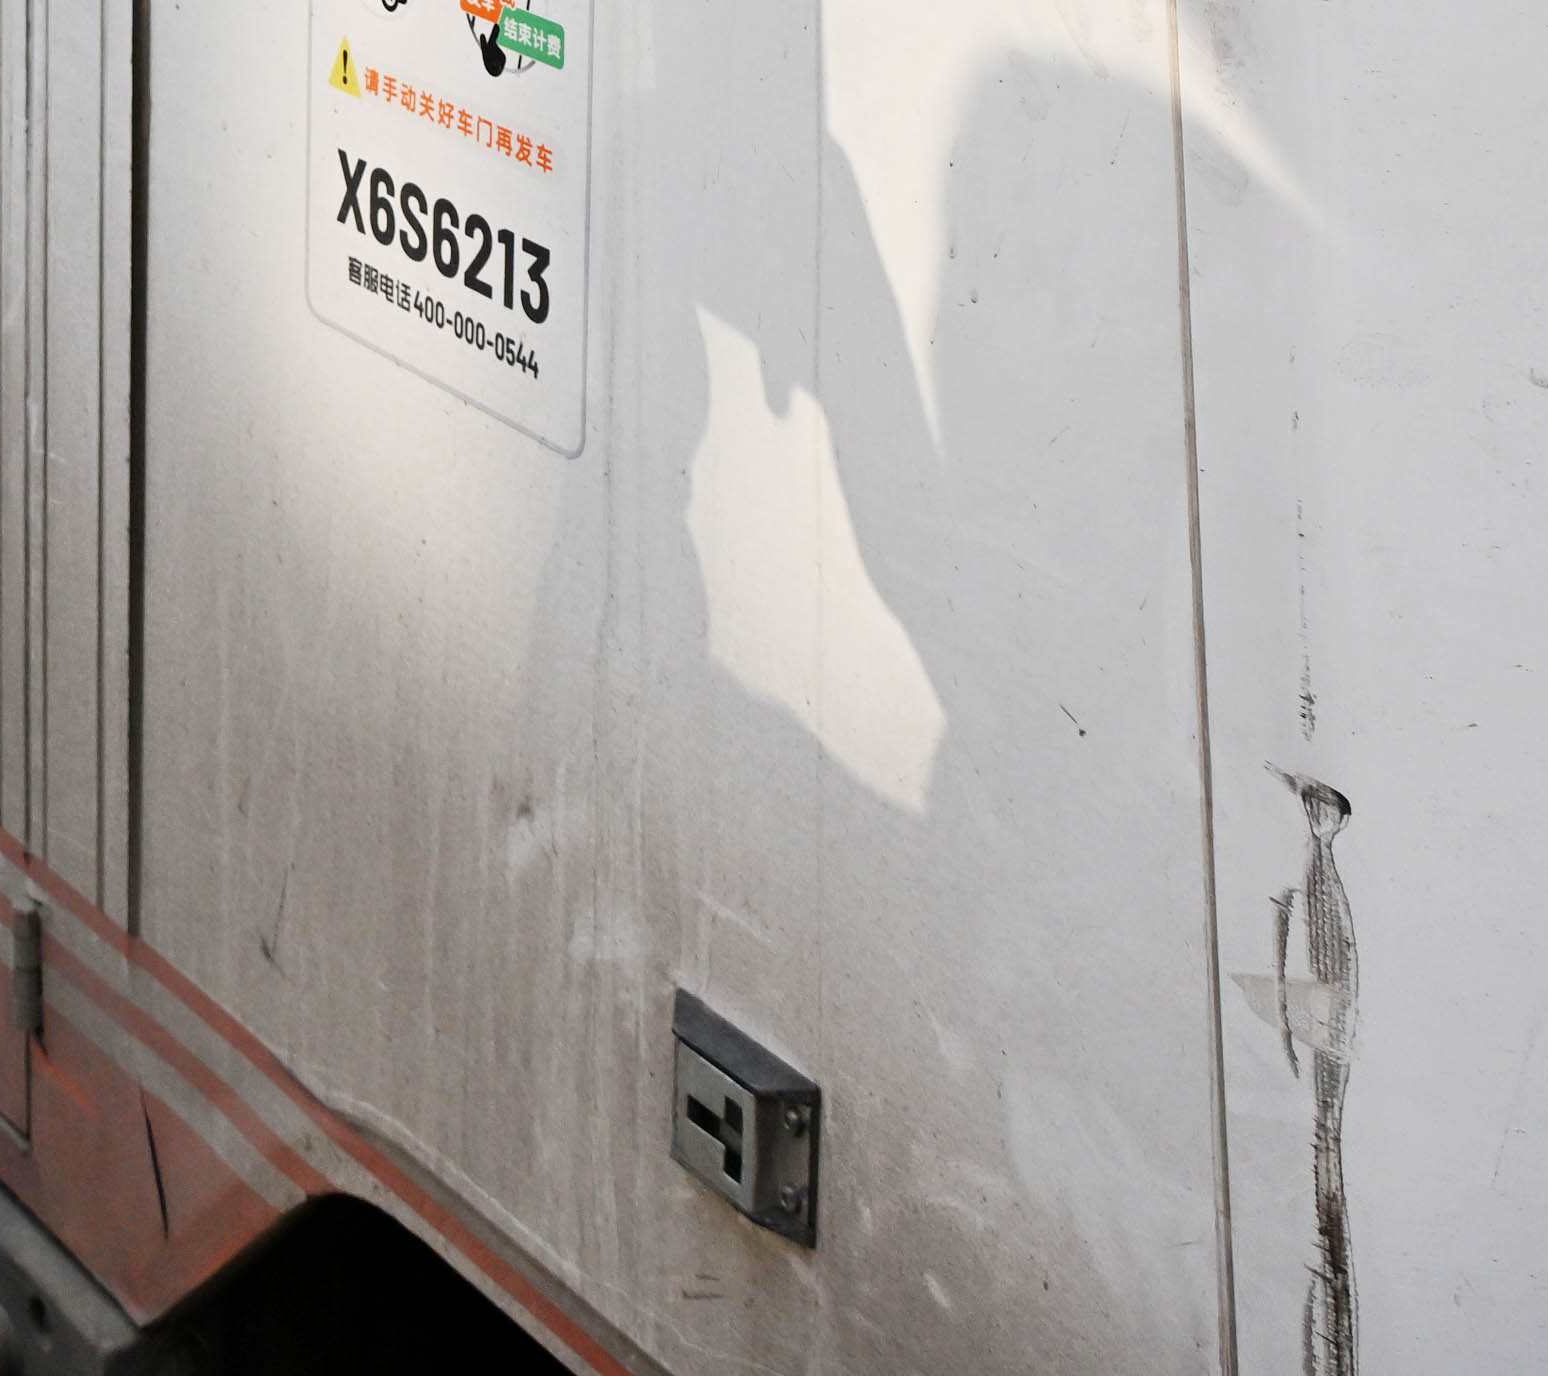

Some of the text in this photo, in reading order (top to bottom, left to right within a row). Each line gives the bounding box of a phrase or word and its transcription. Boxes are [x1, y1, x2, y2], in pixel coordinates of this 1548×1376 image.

[504, 16, 561, 60] 结束计费
[364, 68, 554, 173] 请手动关好车门再发车
[337, 148, 551, 324] X6S6213
[348, 256, 539, 380] 客服电话400-000-0544
